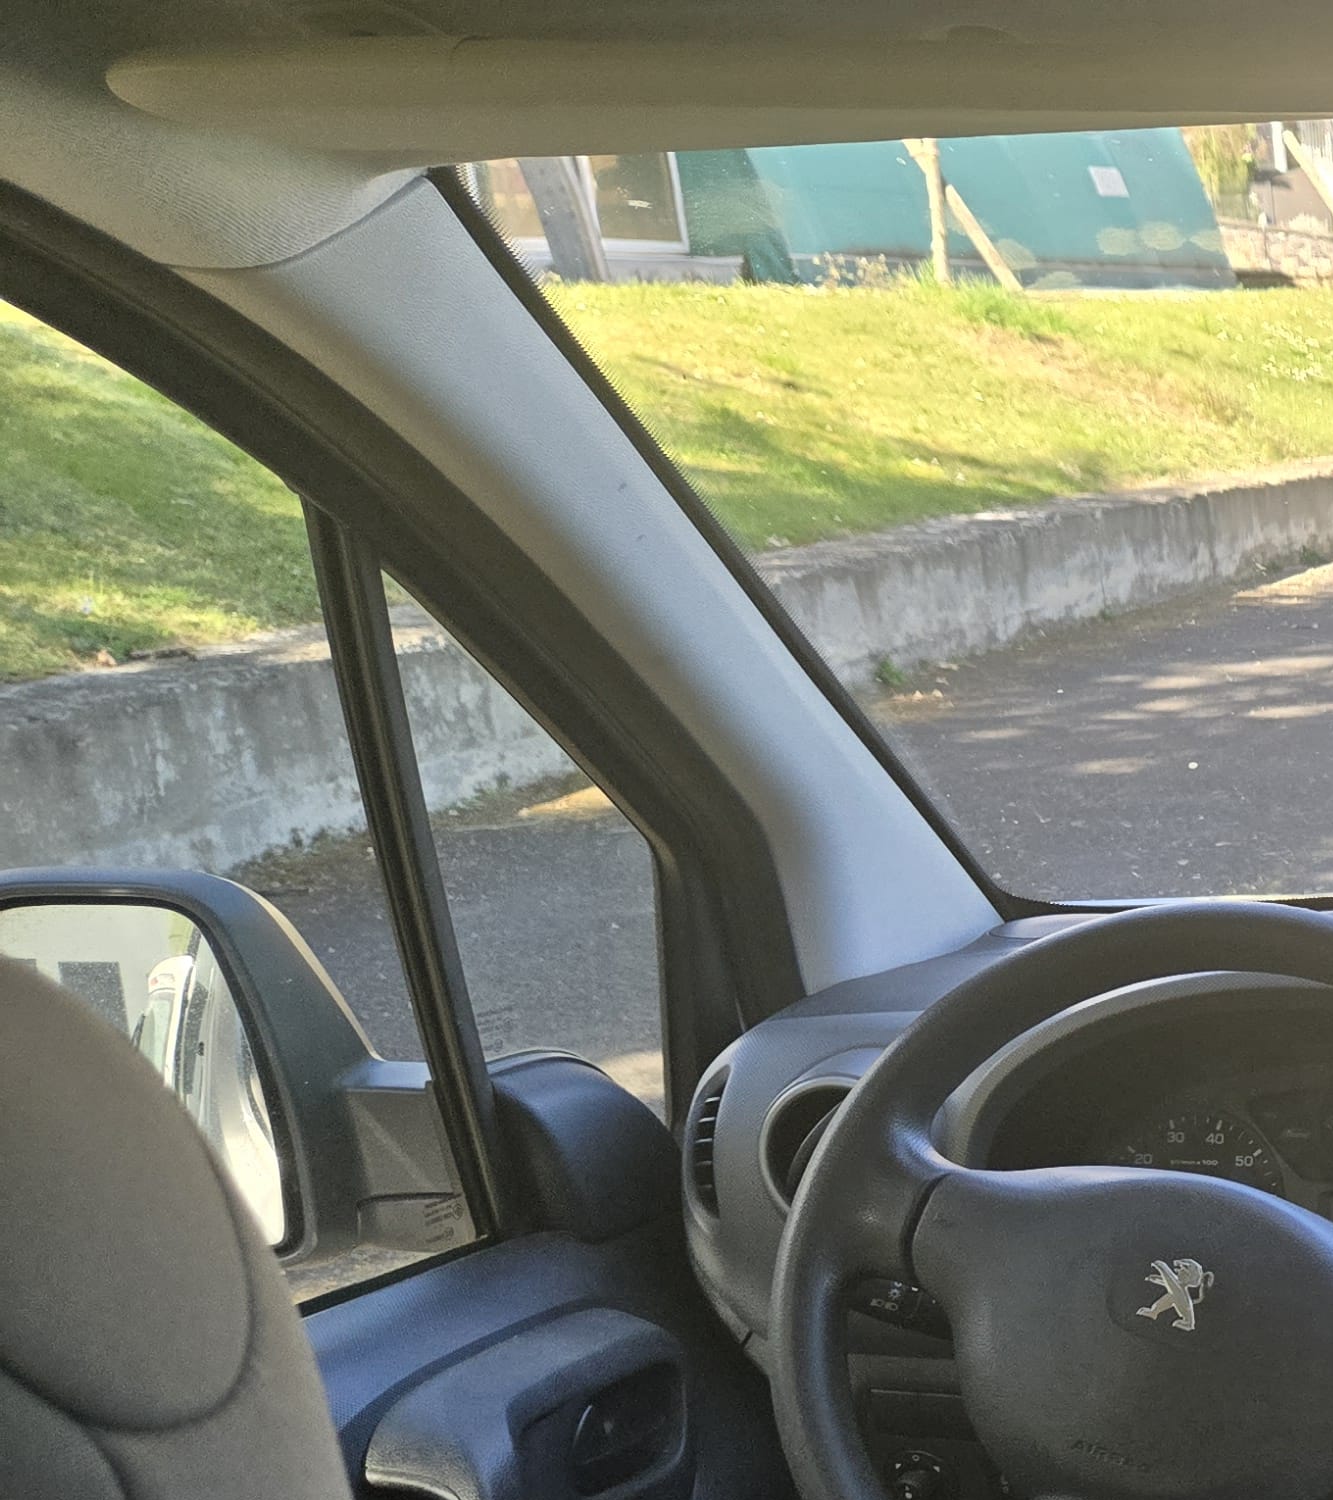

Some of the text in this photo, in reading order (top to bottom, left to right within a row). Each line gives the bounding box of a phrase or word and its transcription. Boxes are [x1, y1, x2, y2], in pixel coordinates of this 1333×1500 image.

[1167, 1131, 1185, 1144] 30
[1205, 1132, 1225, 1145] 40
[1135, 1153, 1153, 1165] 20
[1235, 1155, 1254, 1168] 50
